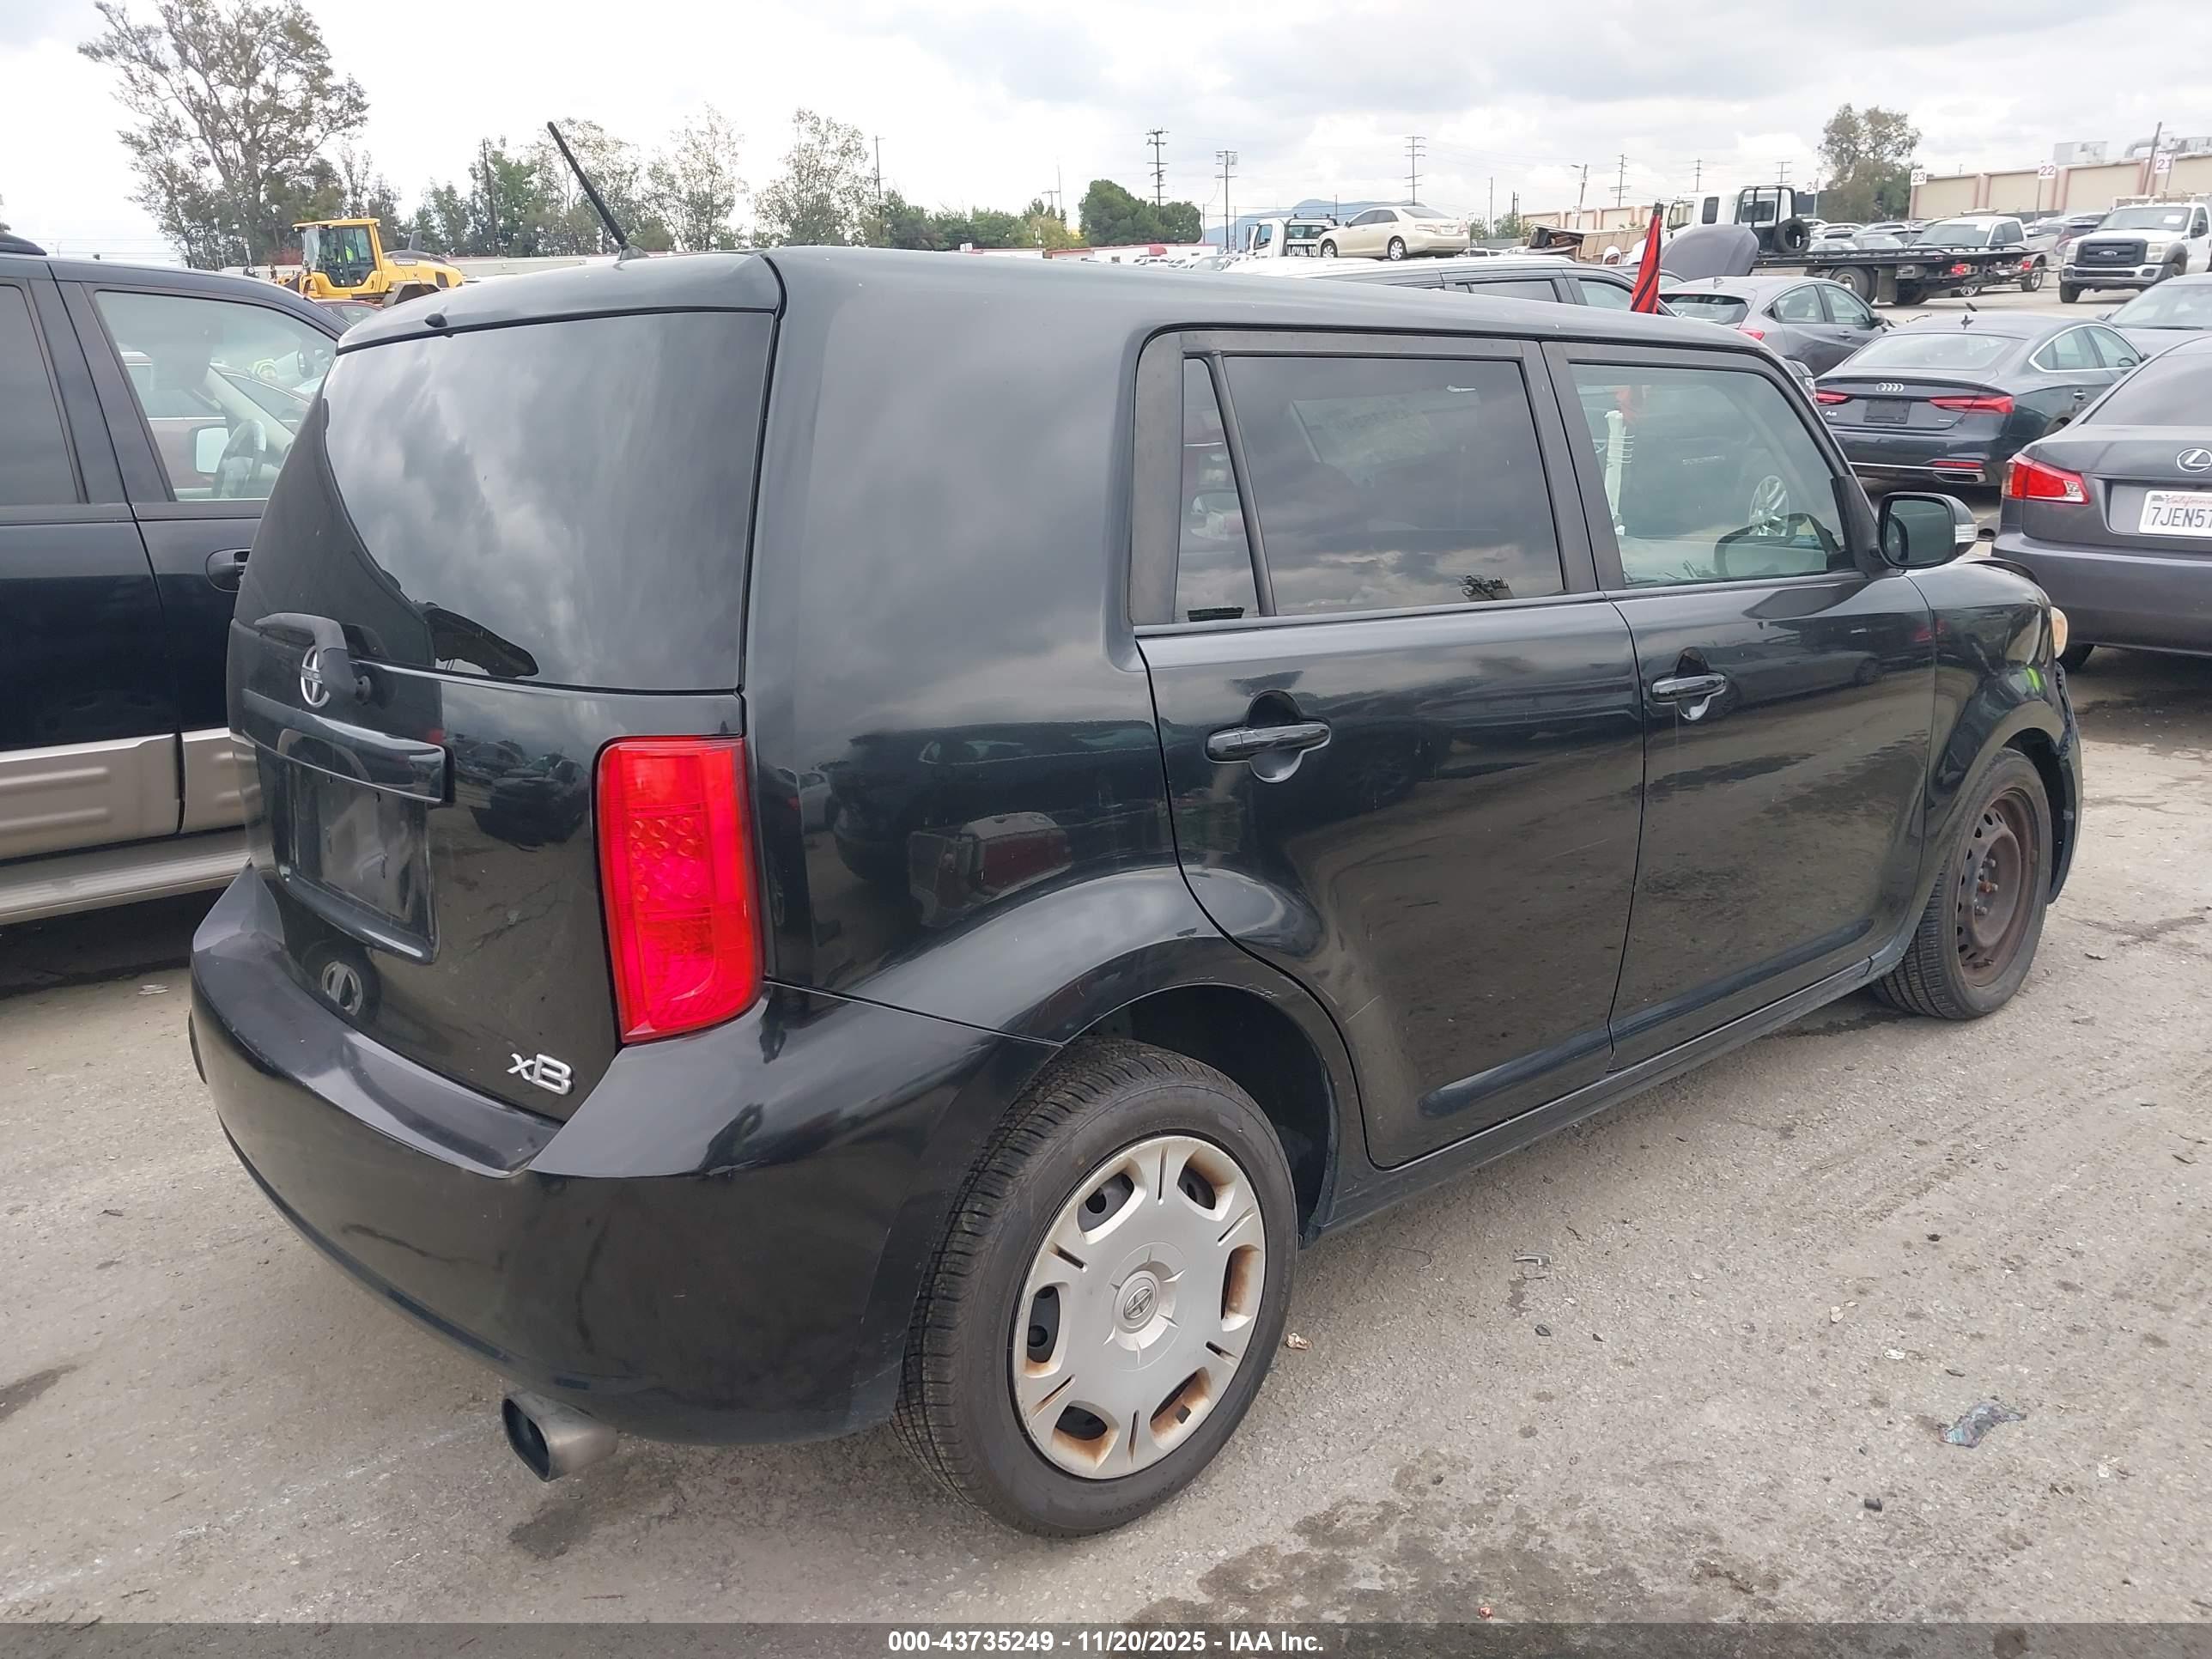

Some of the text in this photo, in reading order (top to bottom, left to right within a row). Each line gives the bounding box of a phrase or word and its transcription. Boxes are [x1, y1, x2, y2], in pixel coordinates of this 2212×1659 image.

[2040, 164, 2055, 176] 22
[2156, 159, 2172, 170] 21
[1912, 171, 1925, 182] 23
[1806, 180, 1819, 192] 24
[1288, 246, 1308, 257] LOYAL
[506, 1052, 574, 1096] xB
